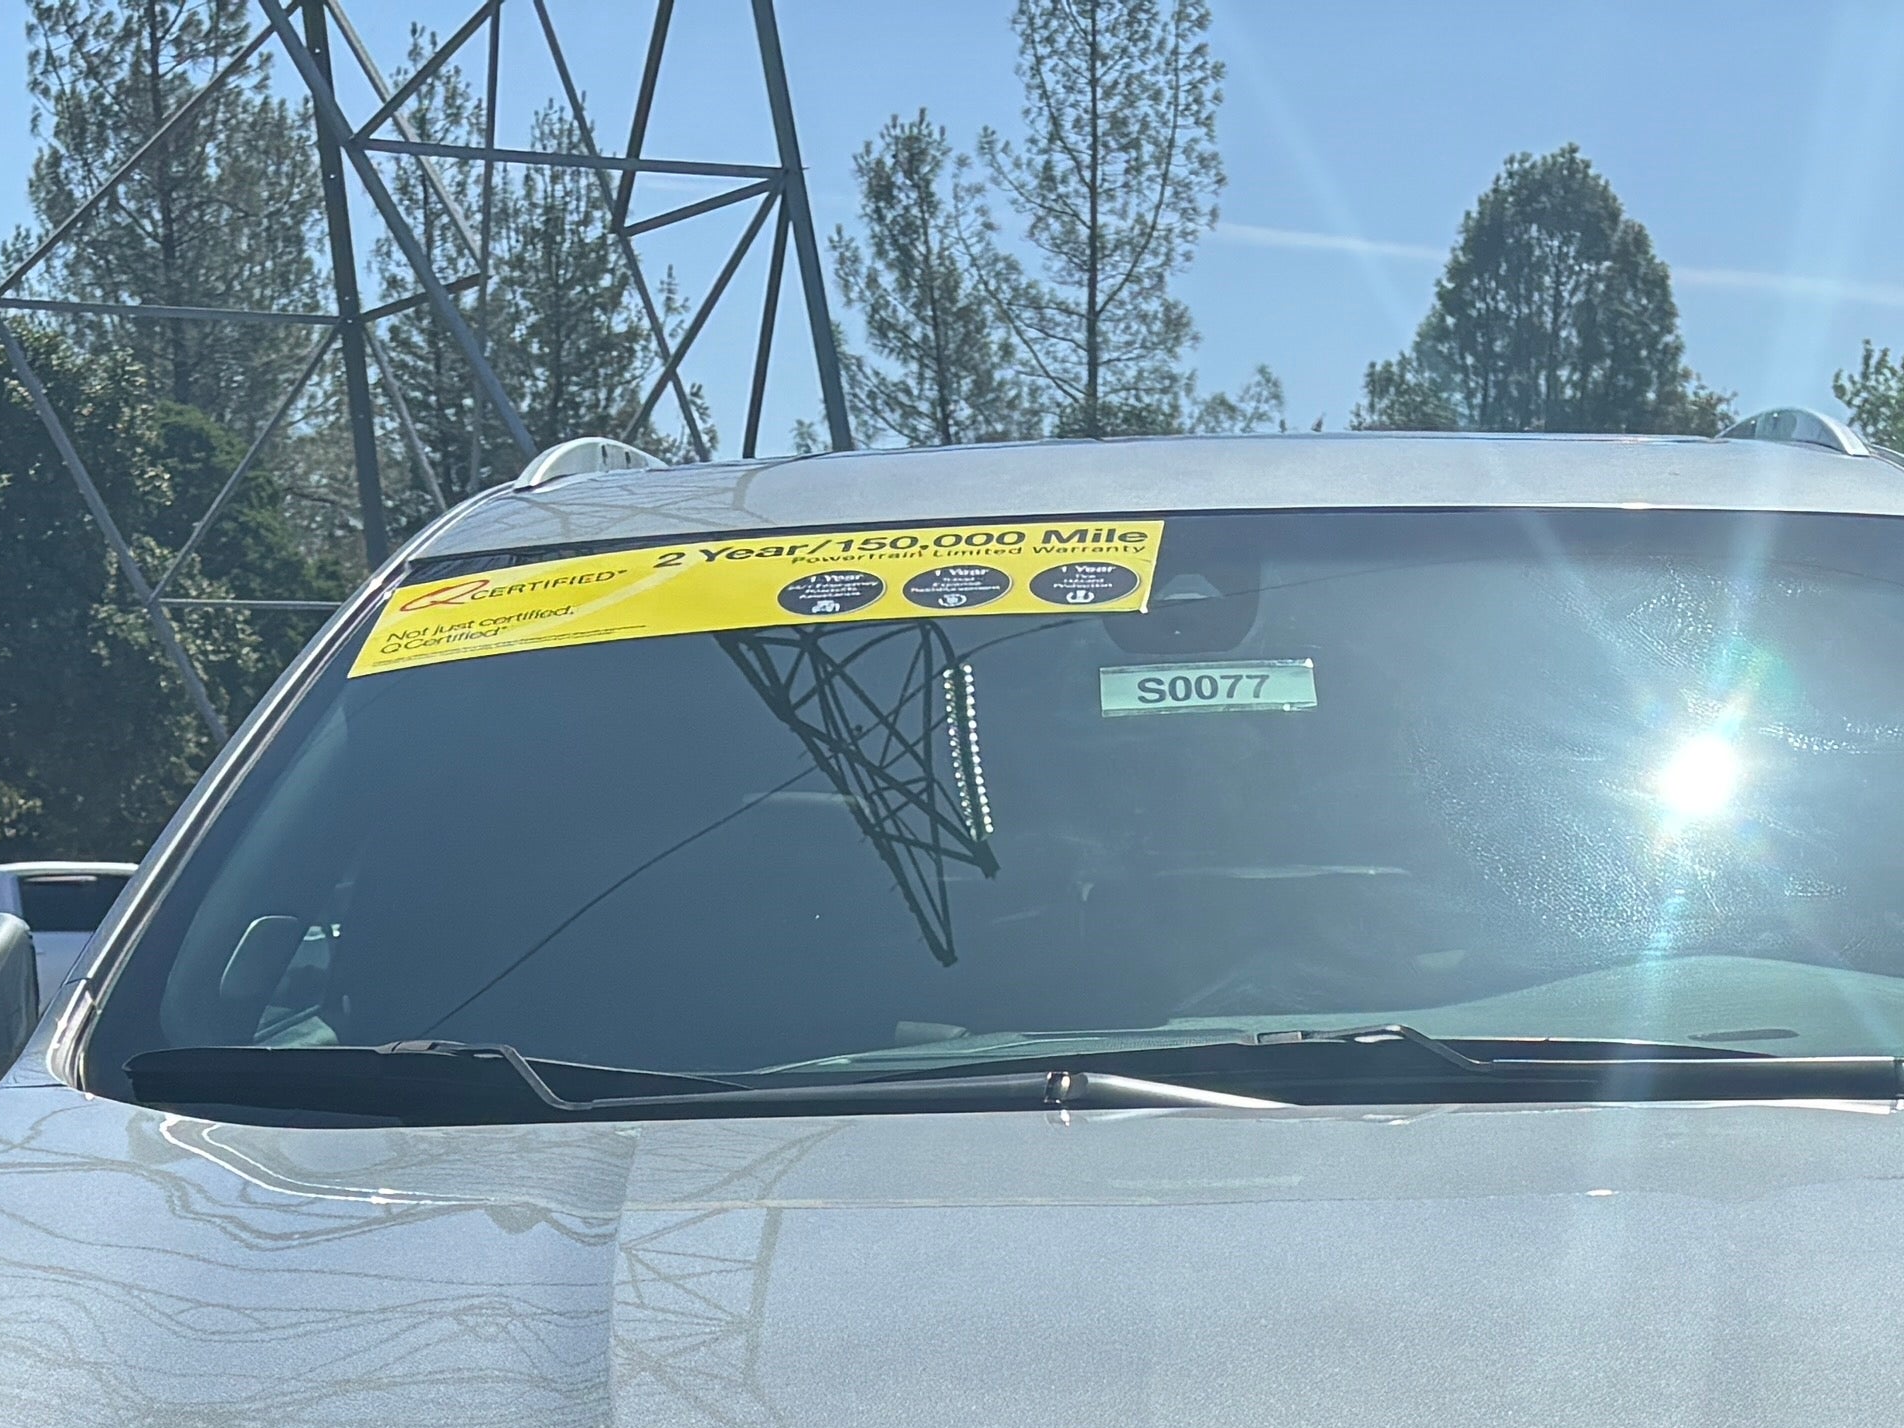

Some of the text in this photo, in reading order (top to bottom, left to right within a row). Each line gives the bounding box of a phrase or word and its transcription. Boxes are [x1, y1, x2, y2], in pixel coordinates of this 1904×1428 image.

[653, 552, 686, 568] 2
[1041, 528, 1148, 544] Mile
[791, 550, 922, 564] Powertrain
[933, 546, 1022, 557] Limited
[825, 573, 865, 582] Year
[949, 566, 989, 576] Year
[386, 605, 574, 642] Not just certified.
[1137, 674, 1270, 704] S0077
